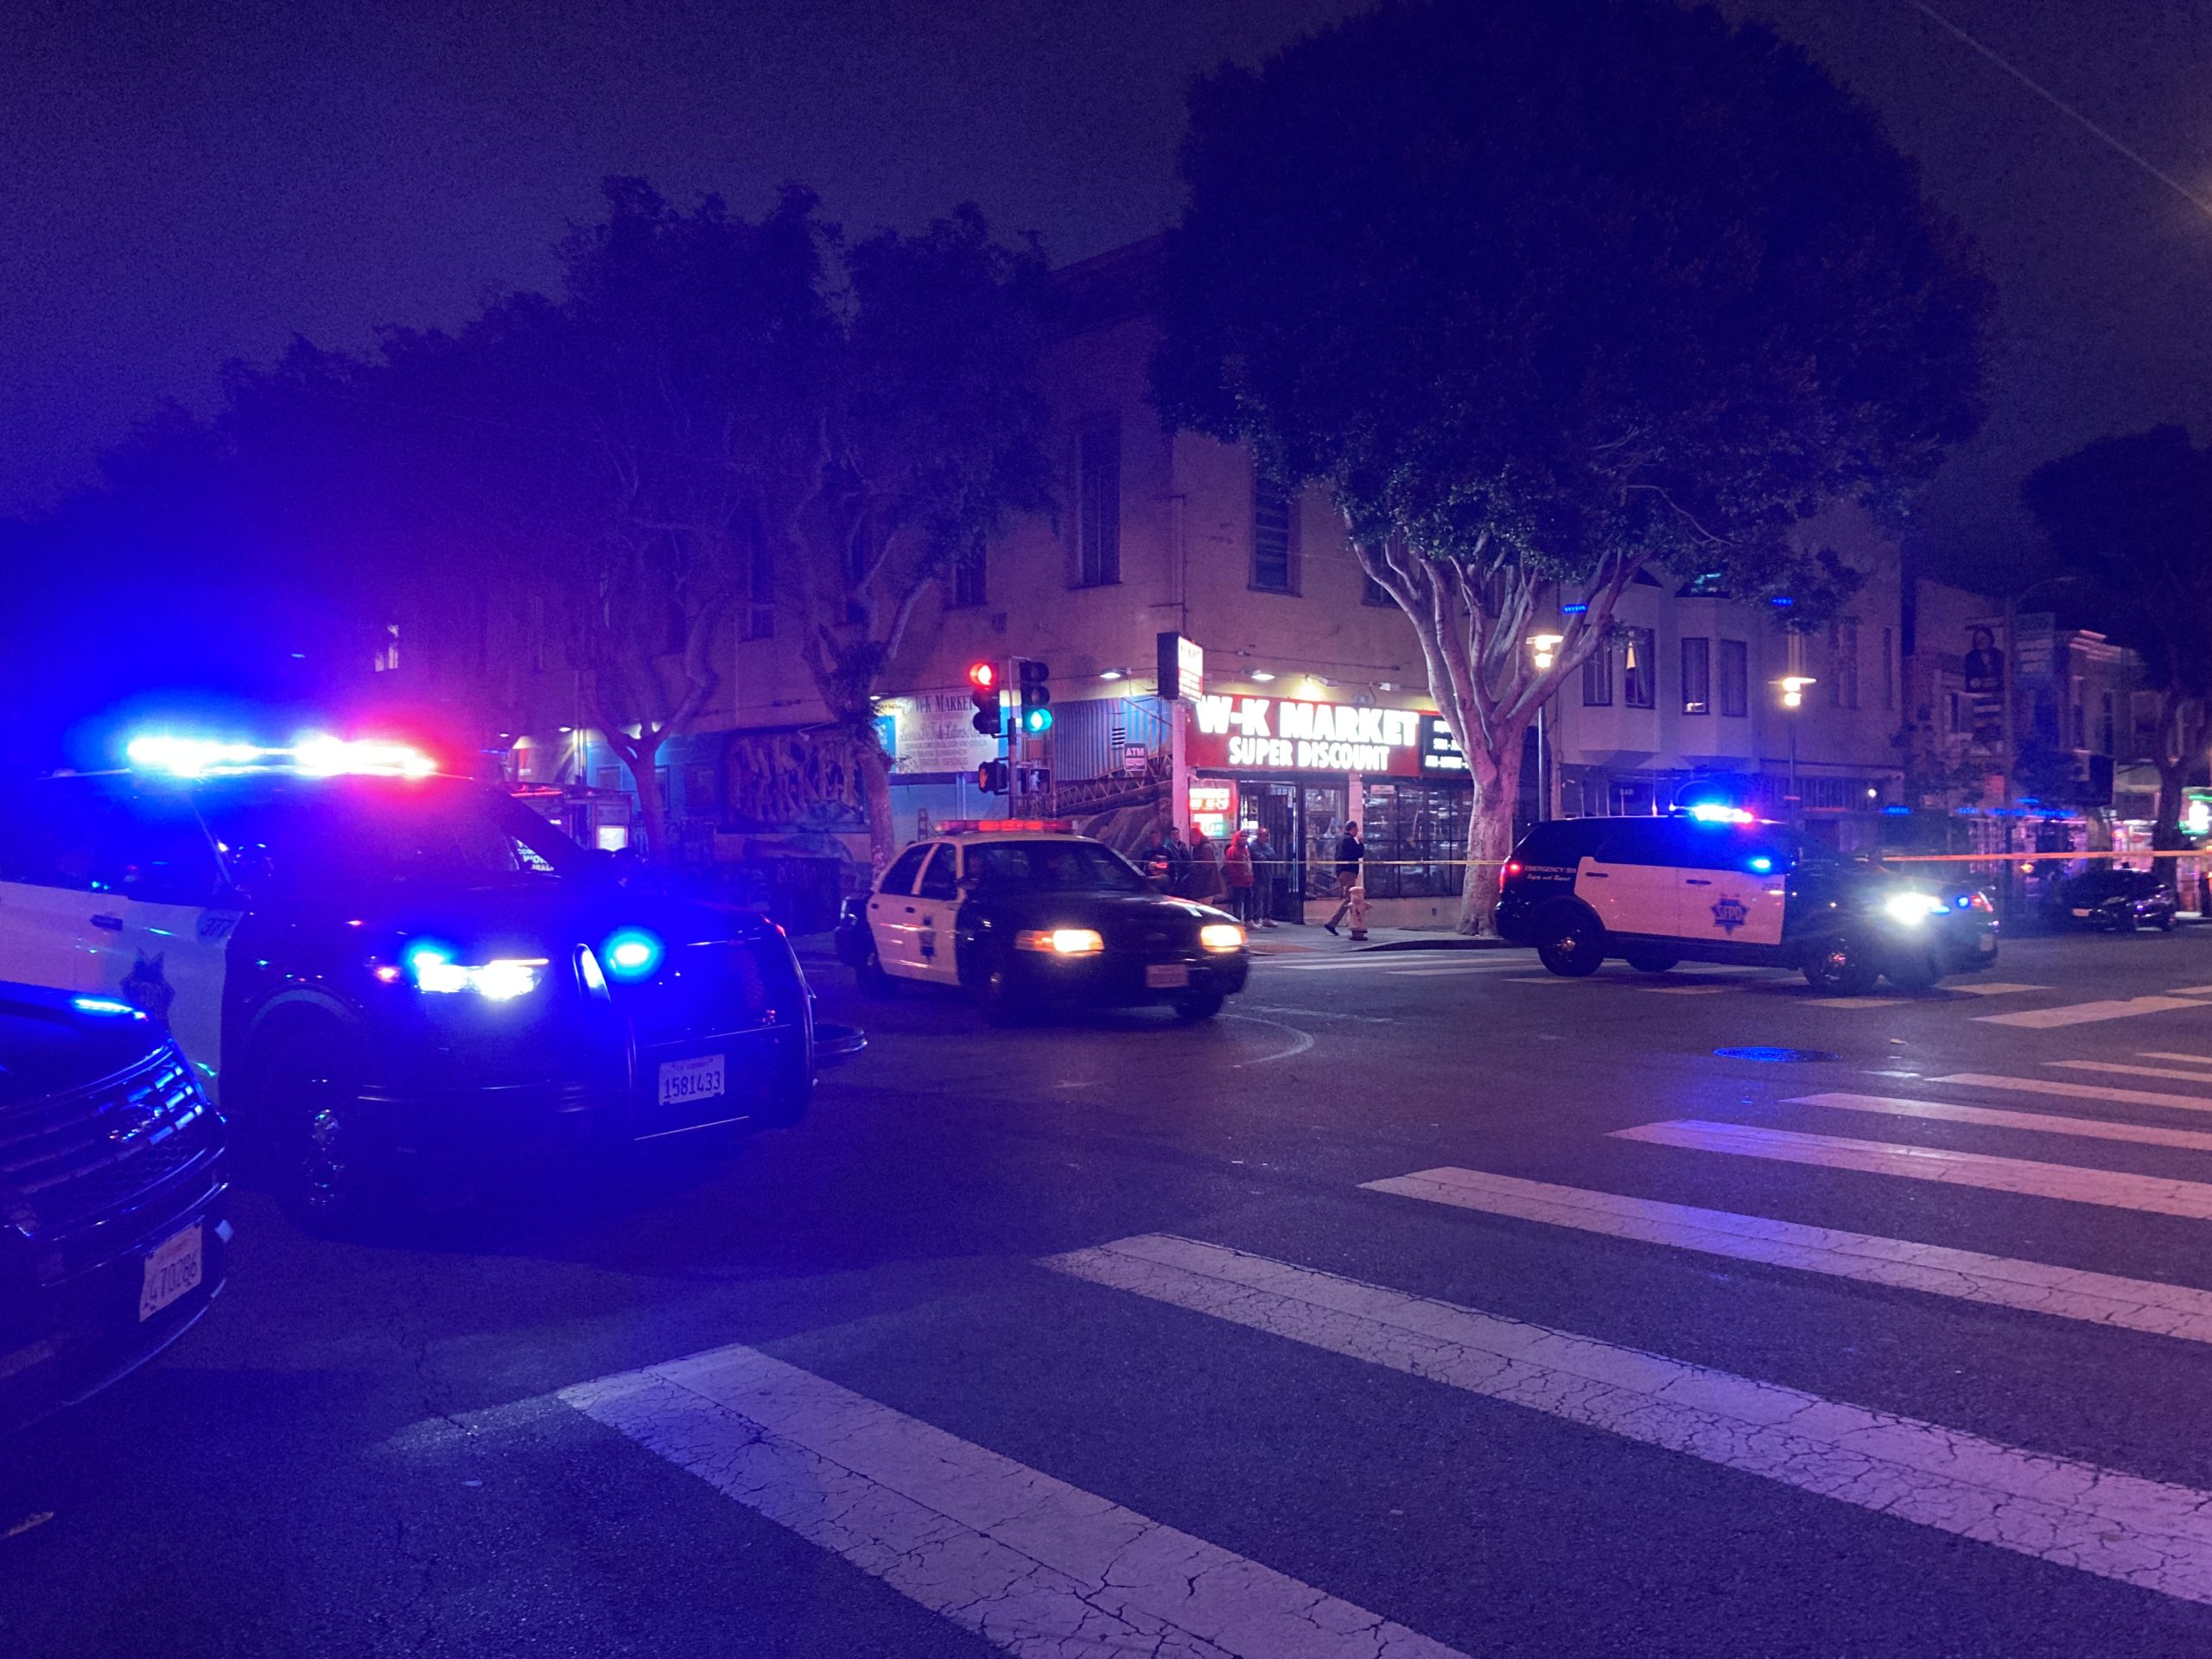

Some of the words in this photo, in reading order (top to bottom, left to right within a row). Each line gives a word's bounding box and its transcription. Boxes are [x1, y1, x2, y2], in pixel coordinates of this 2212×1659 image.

[1195, 695, 1271, 737] W-K
[1280, 701, 1420, 747] MARKET
[1126, 747, 1145, 757] ATM
[1229, 736, 1294, 766] SUPER
[1298, 741, 1390, 771] DISCOUNT
[663, 1071, 721, 1099] 1581433
